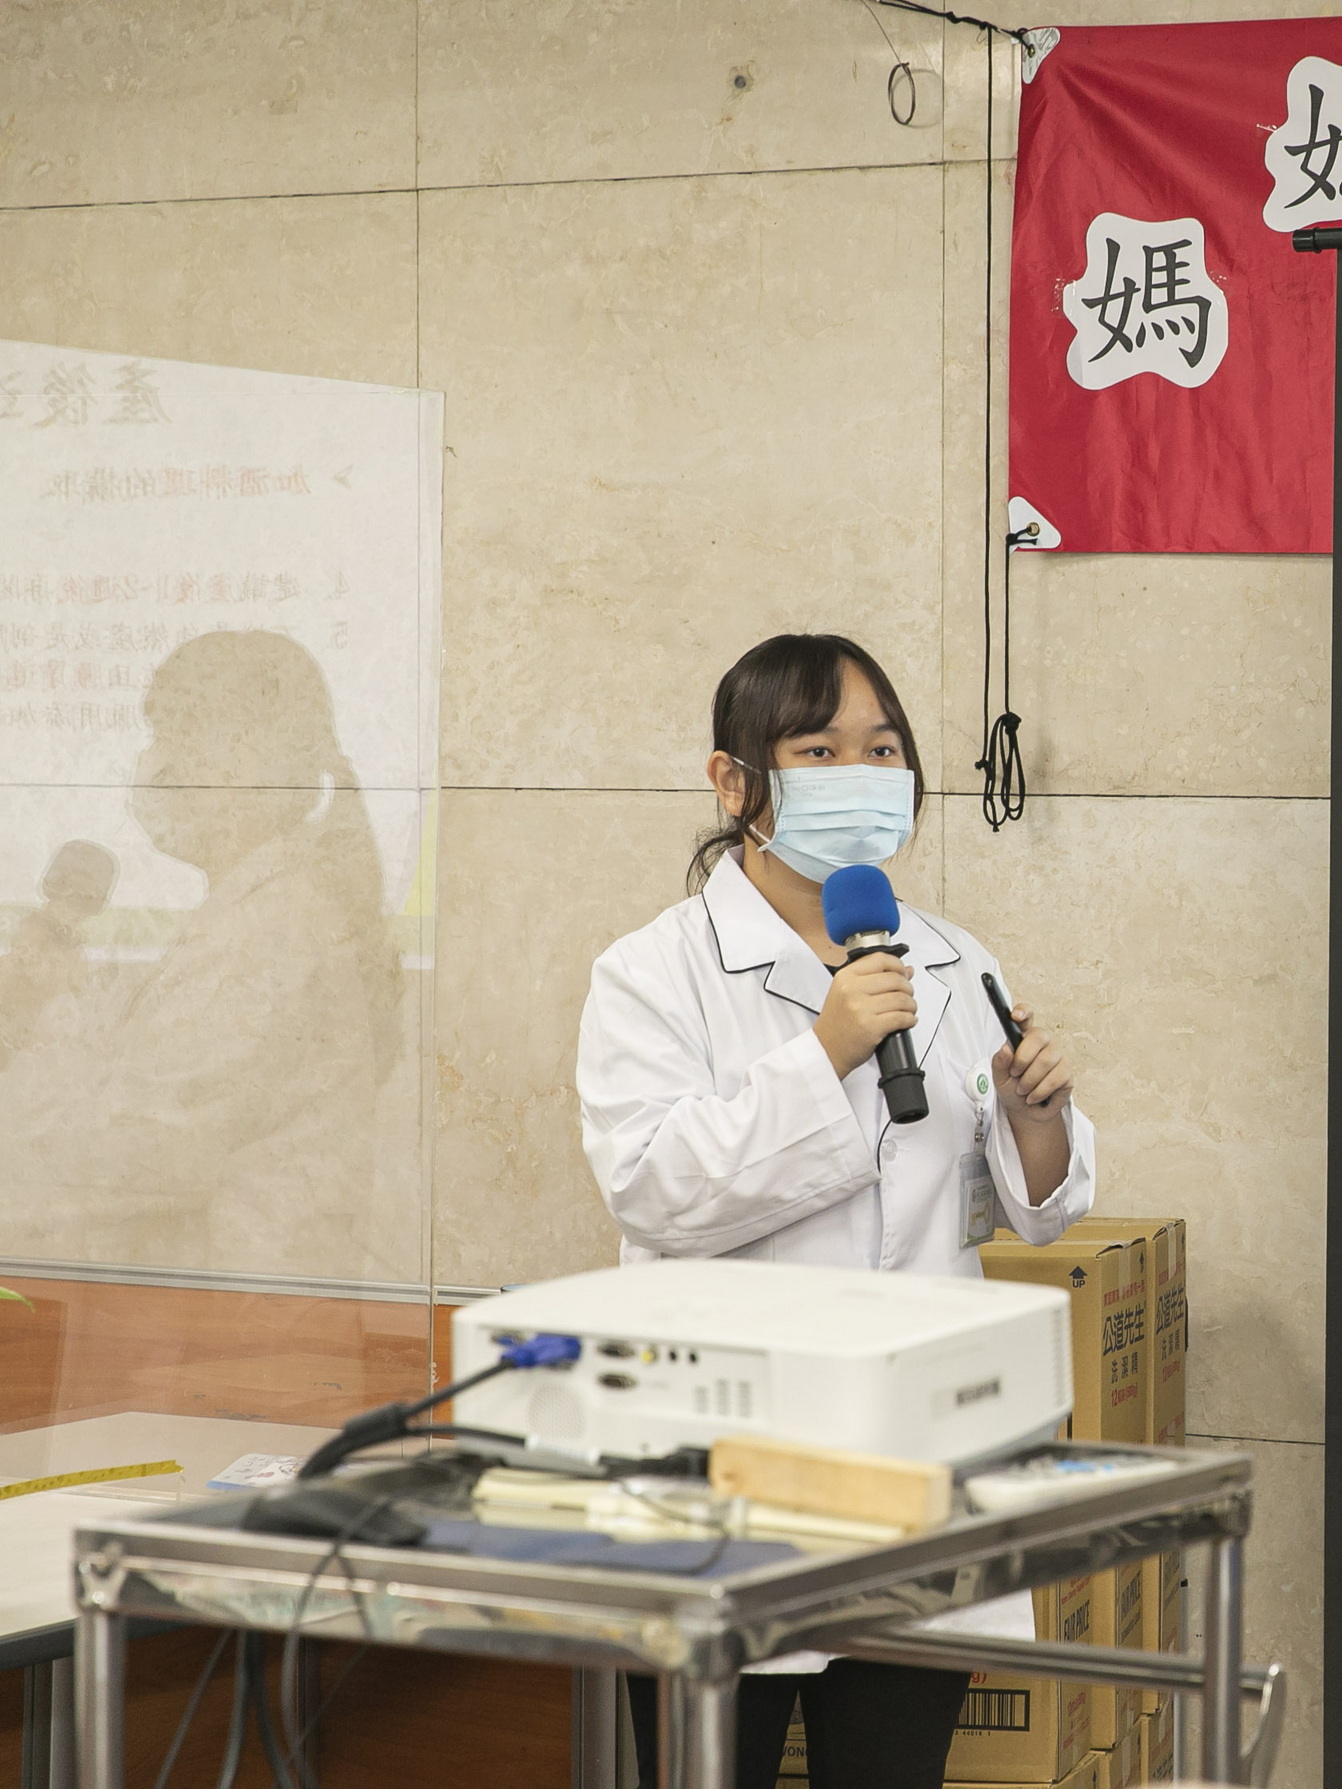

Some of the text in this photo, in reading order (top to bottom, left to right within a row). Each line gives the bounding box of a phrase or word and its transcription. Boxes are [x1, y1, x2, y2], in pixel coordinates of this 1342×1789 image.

[1082, 238, 1212, 367] 媽
[1072, 1279, 1086, 1289] UP
[1102, 1302, 1145, 1357] 公道先生
